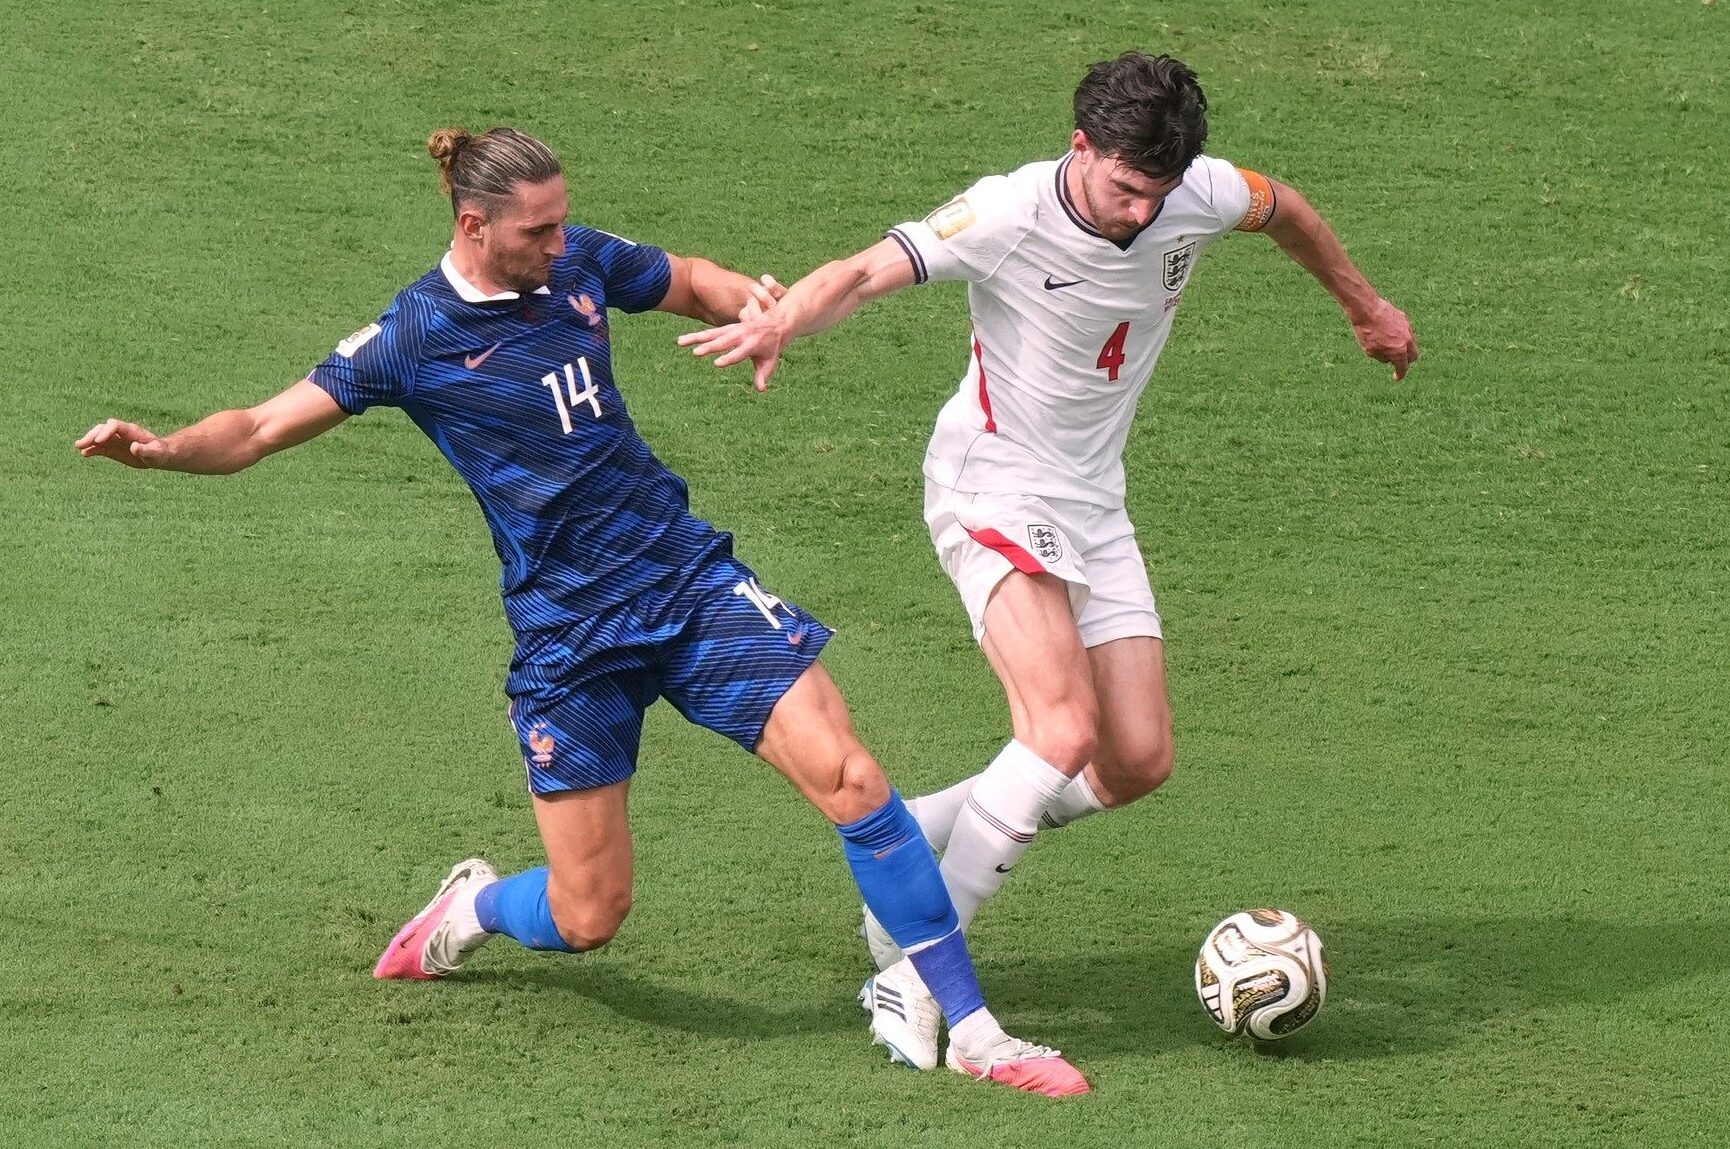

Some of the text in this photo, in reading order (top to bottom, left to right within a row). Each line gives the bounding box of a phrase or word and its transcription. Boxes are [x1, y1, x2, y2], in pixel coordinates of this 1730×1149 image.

[1096, 321, 1130, 381] 4
[541, 356, 603, 435] 14
[733, 576, 797, 630] 14
